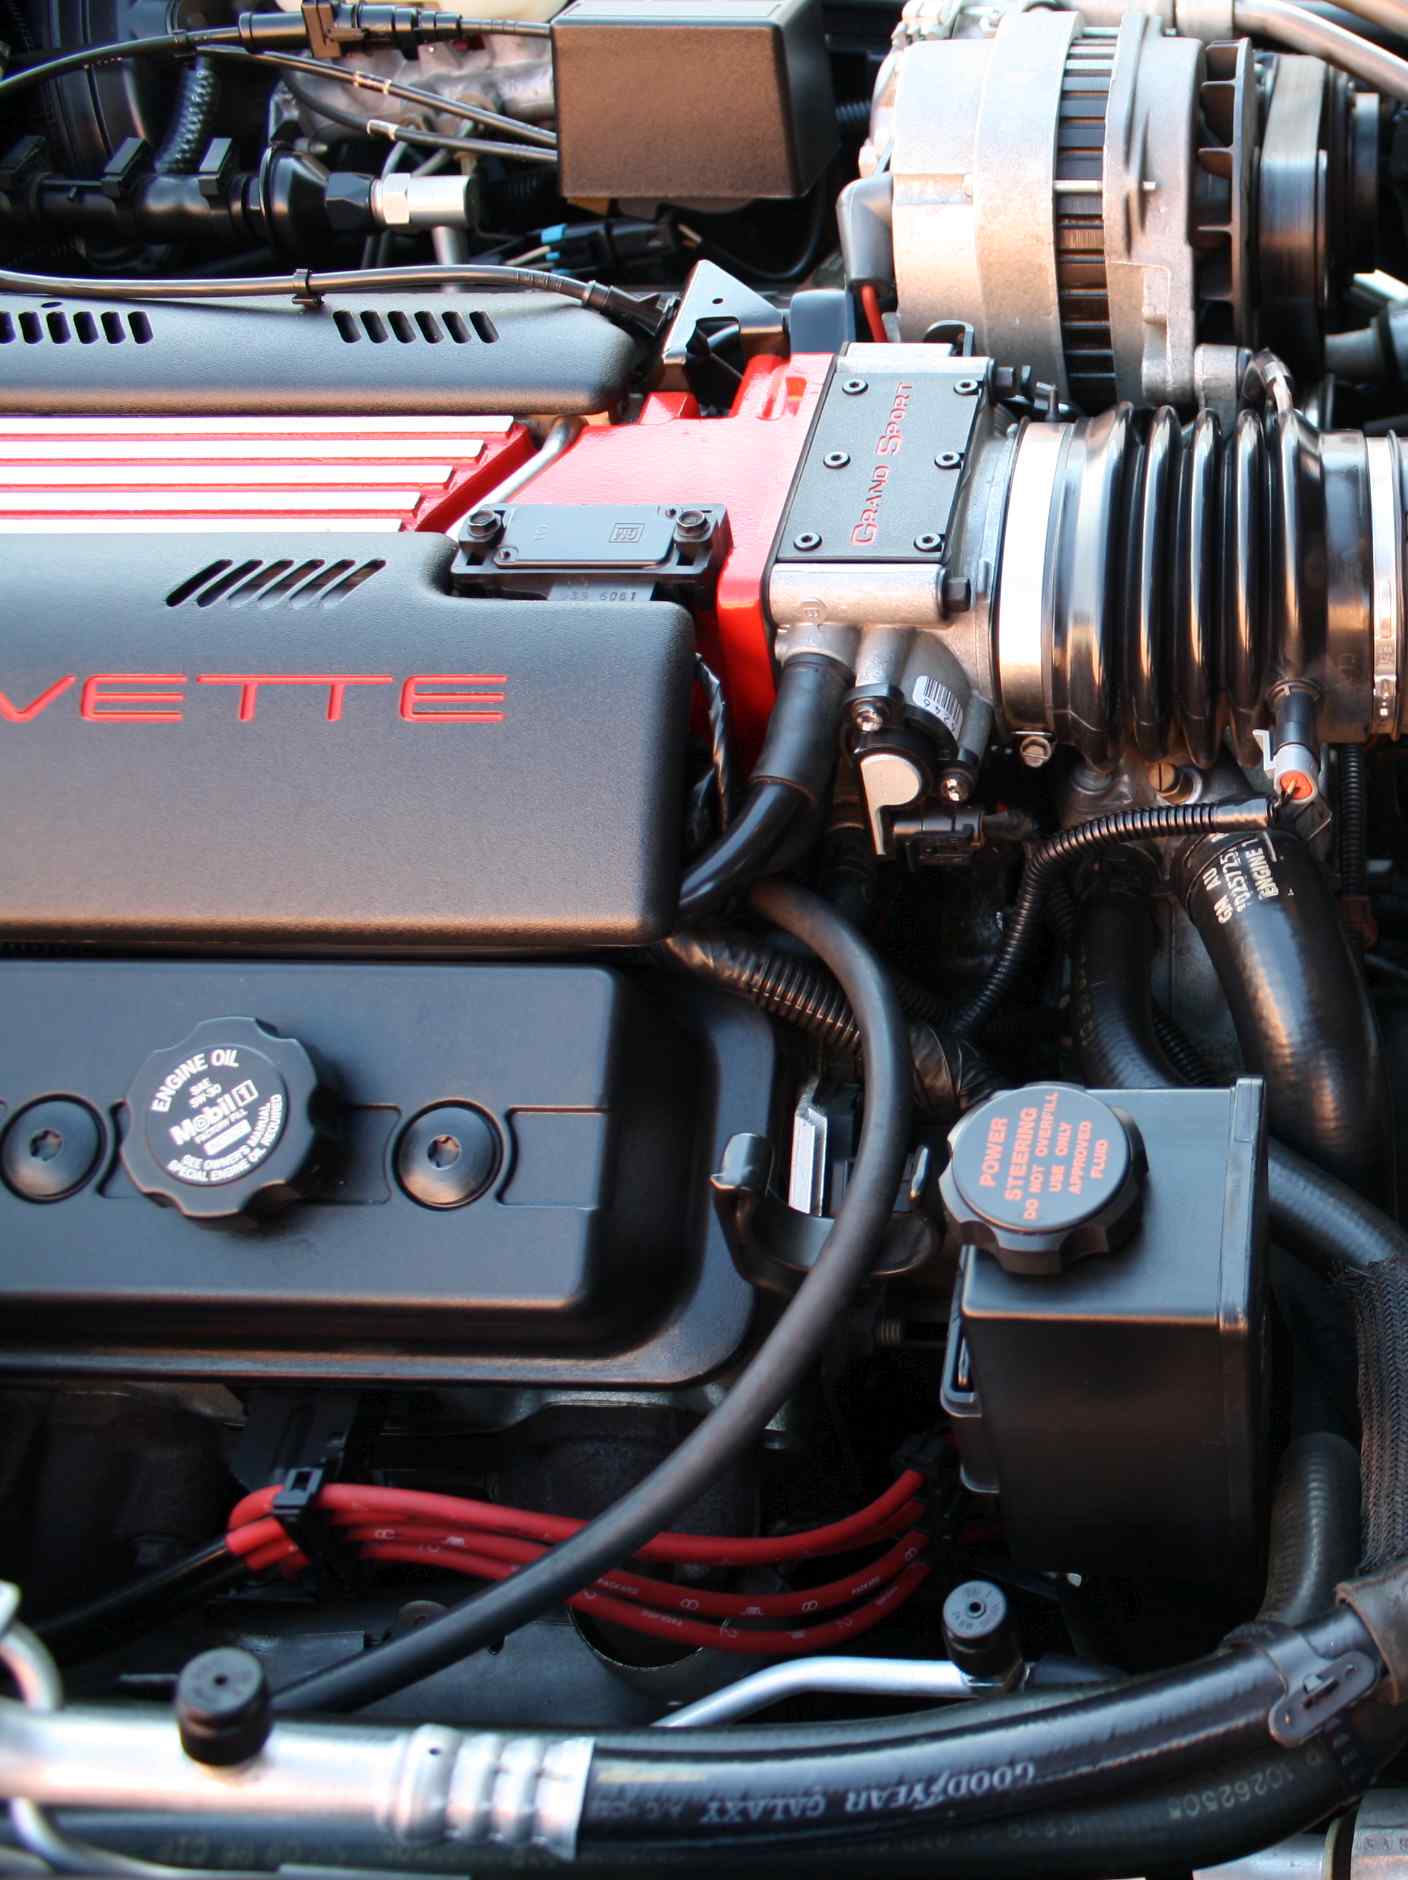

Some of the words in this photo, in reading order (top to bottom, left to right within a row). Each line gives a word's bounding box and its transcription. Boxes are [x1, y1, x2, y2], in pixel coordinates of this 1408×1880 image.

[850, 464, 890, 546] GRAND
[875, 382, 913, 455] SPORT
[1246, 847, 1279, 898] ENGINE
[1214, 895, 1233, 924] GM
[151, 1053, 208, 1112] ENGINE
[211, 1049, 239, 1067] OIL
[169, 1093, 236, 1145] Mobil
[260, 1094, 283, 1147] REQUIRED
[1035, 1091, 1060, 1157] OVERFILL
[1055, 1121, 1072, 1156] ONLY
[979, 1117, 1008, 1187] POWER
[1003, 1107, 1039, 1201] STEERING
[1068, 1119, 1093, 1195] APPROVED
[1090, 1138, 1109, 1179] FLUID
[1028, 1164, 1045, 1193] NOT
[1049, 1165, 1065, 1192] USE
[1023, 1199, 1040, 1220] DO
[700, 1786, 828, 1824] GALAXY
[844, 1761, 1036, 1812] GOODYEAR
